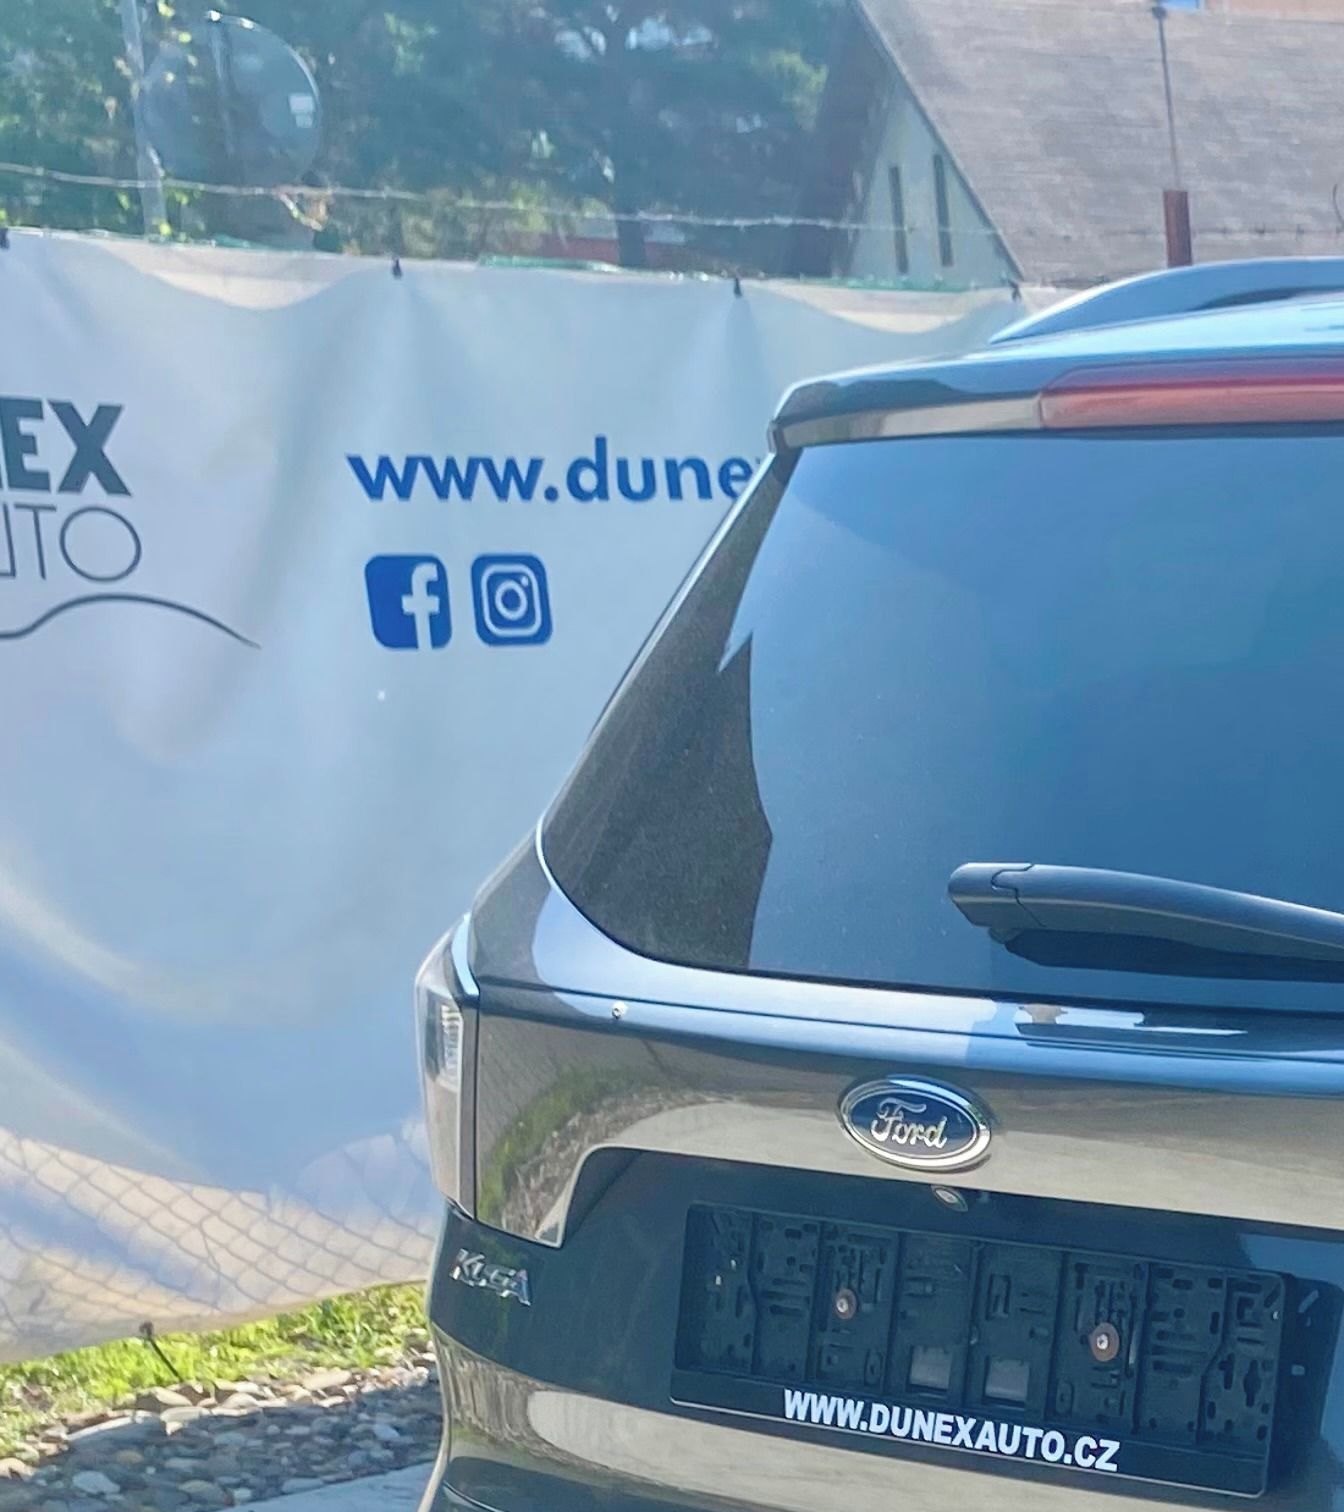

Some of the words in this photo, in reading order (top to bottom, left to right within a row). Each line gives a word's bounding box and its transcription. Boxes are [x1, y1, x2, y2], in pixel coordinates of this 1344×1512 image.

[0, 395, 133, 497] EX
[344, 436, 761, 502] www.dune
[870, 1097, 948, 1149] Ford
[783, 1388, 1121, 1473] WWW.DUNEXAUTO.CZ
